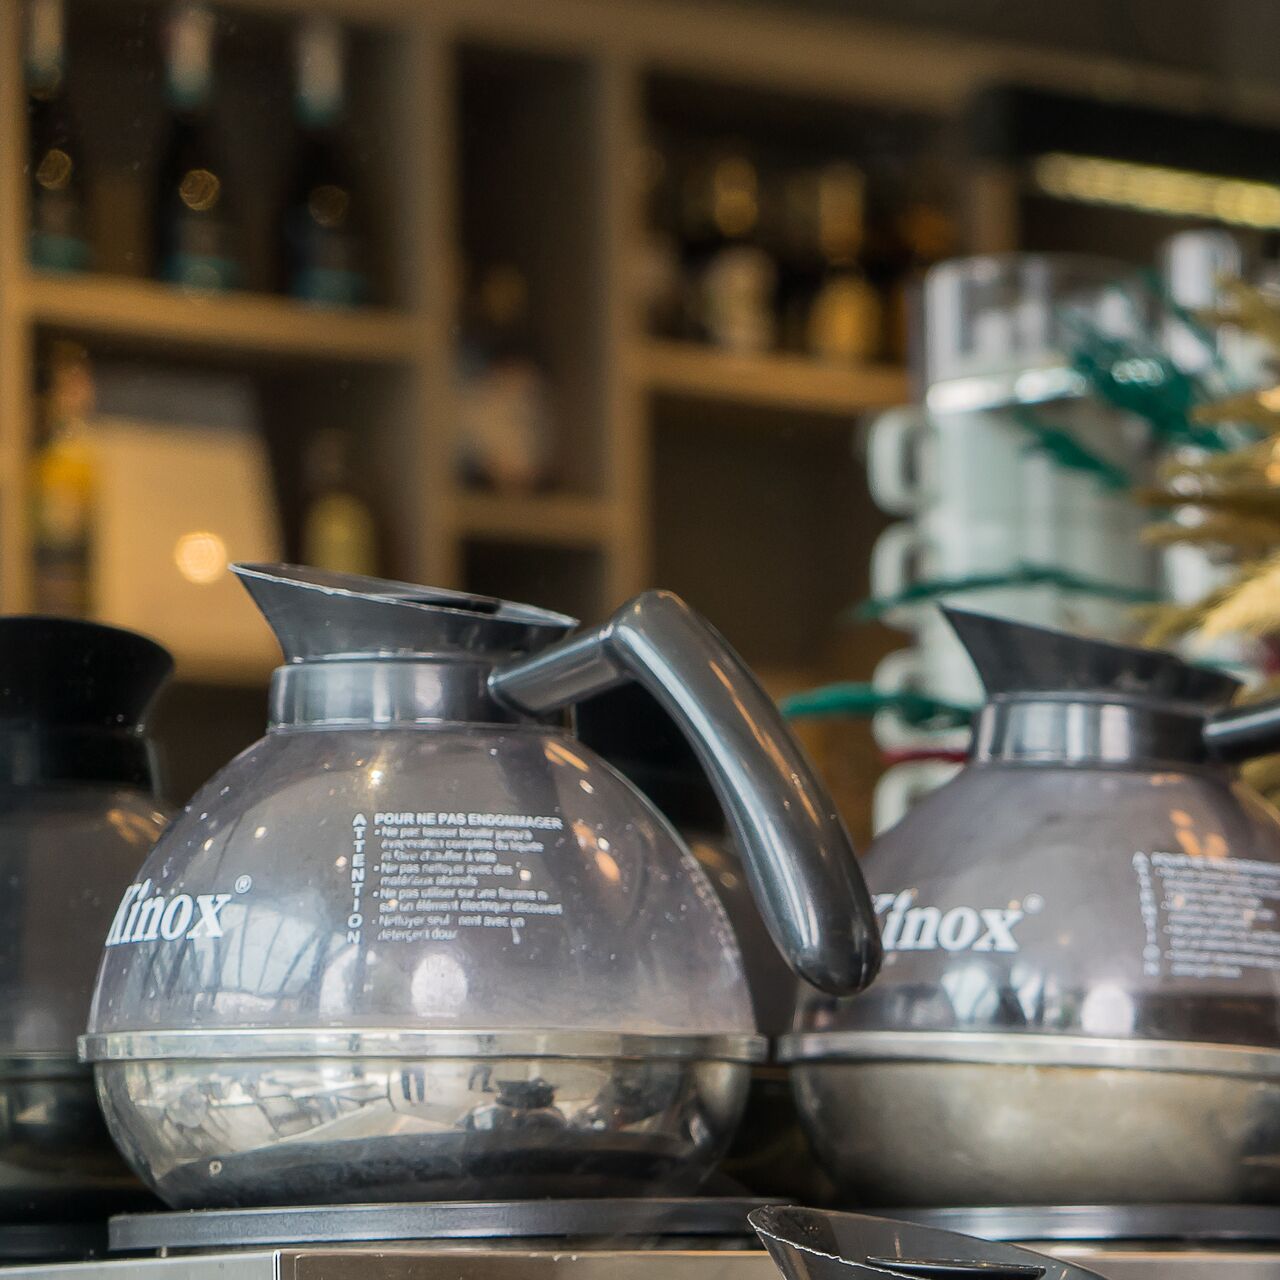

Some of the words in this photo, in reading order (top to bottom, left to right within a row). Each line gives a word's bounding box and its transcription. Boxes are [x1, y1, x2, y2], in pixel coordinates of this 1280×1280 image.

[374, 813, 415, 825] POUR
[417, 813, 437, 825] NE
[438, 813, 466, 826] PAS
